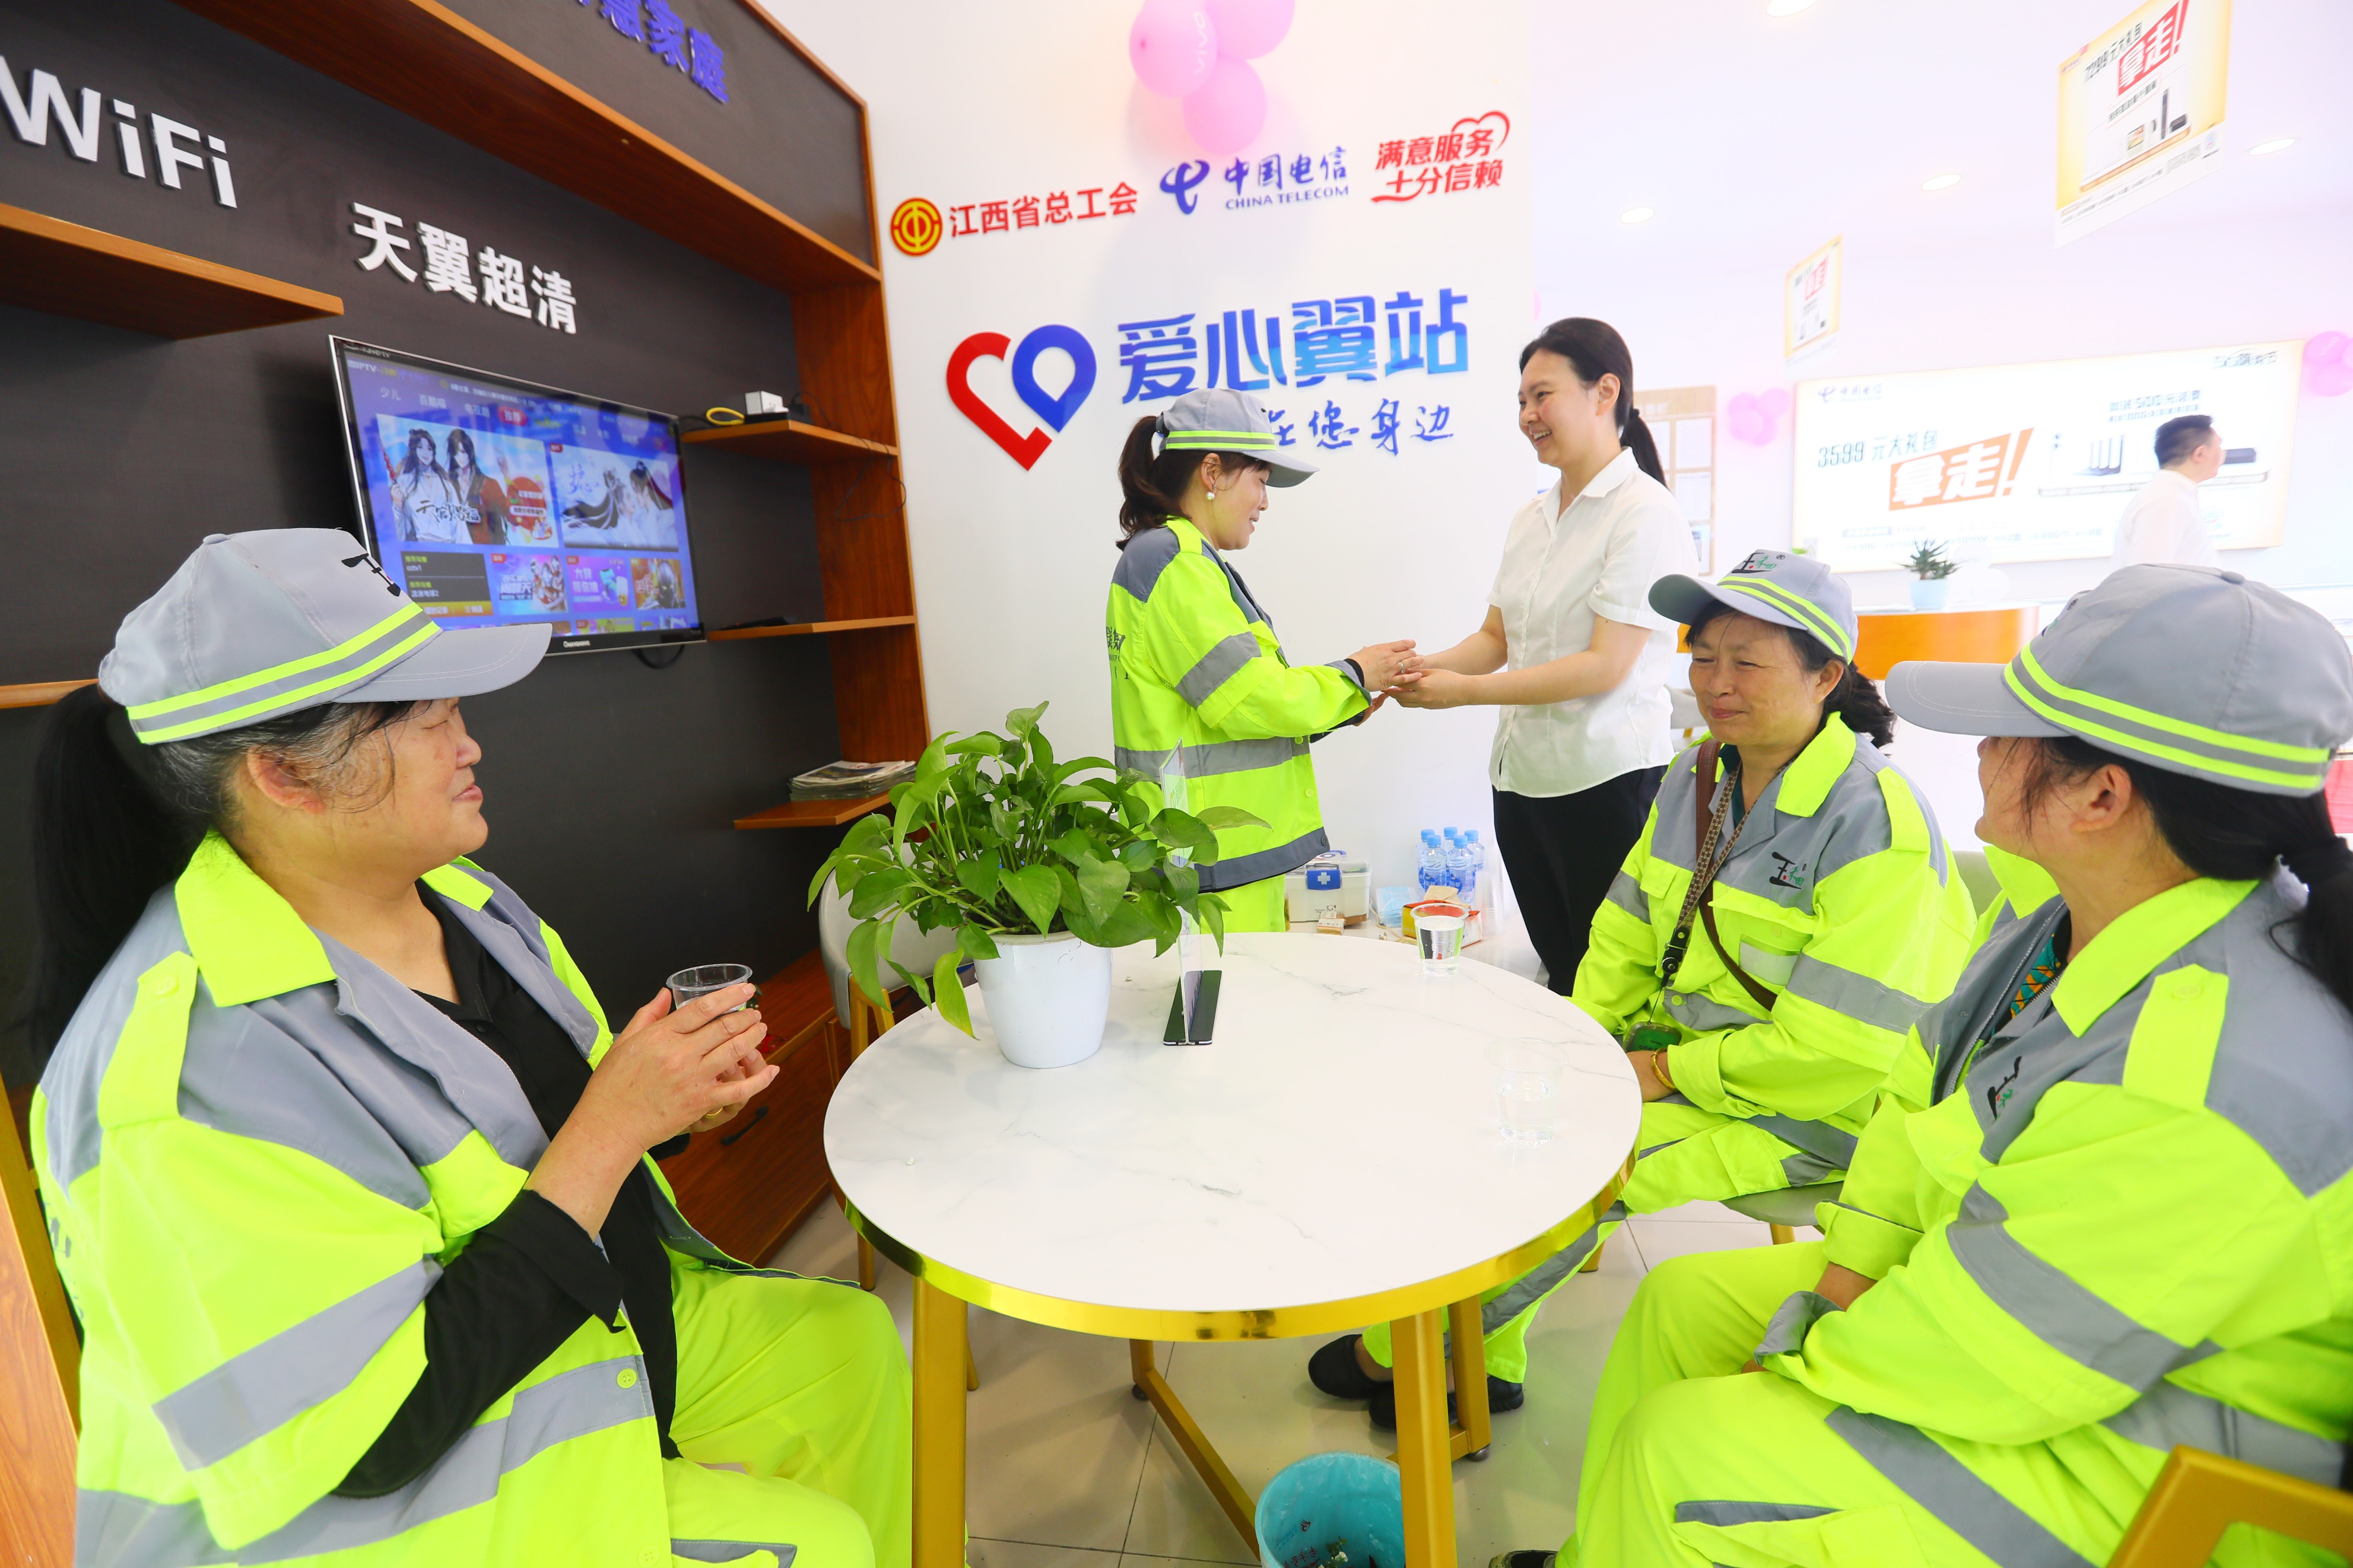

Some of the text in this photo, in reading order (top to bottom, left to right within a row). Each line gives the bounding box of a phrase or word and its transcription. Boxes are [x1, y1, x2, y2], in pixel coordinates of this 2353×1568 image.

[0, 56, 237, 208] WiFi
[1375, 129, 1494, 170] 满意服务
[1225, 145, 1347, 195] 中国电信
[1225, 184, 1349, 209] CHINA TELECOM
[1372, 159, 1504, 202] 十分信赖
[950, 182, 1138, 237] 江西省总工会
[353, 202, 577, 335] 天翼超清
[1118, 287, 1469, 405] 爱心翼站
[1268, 397, 1454, 456] 在您身边
[1892, 427, 2034, 506] 拿走!
